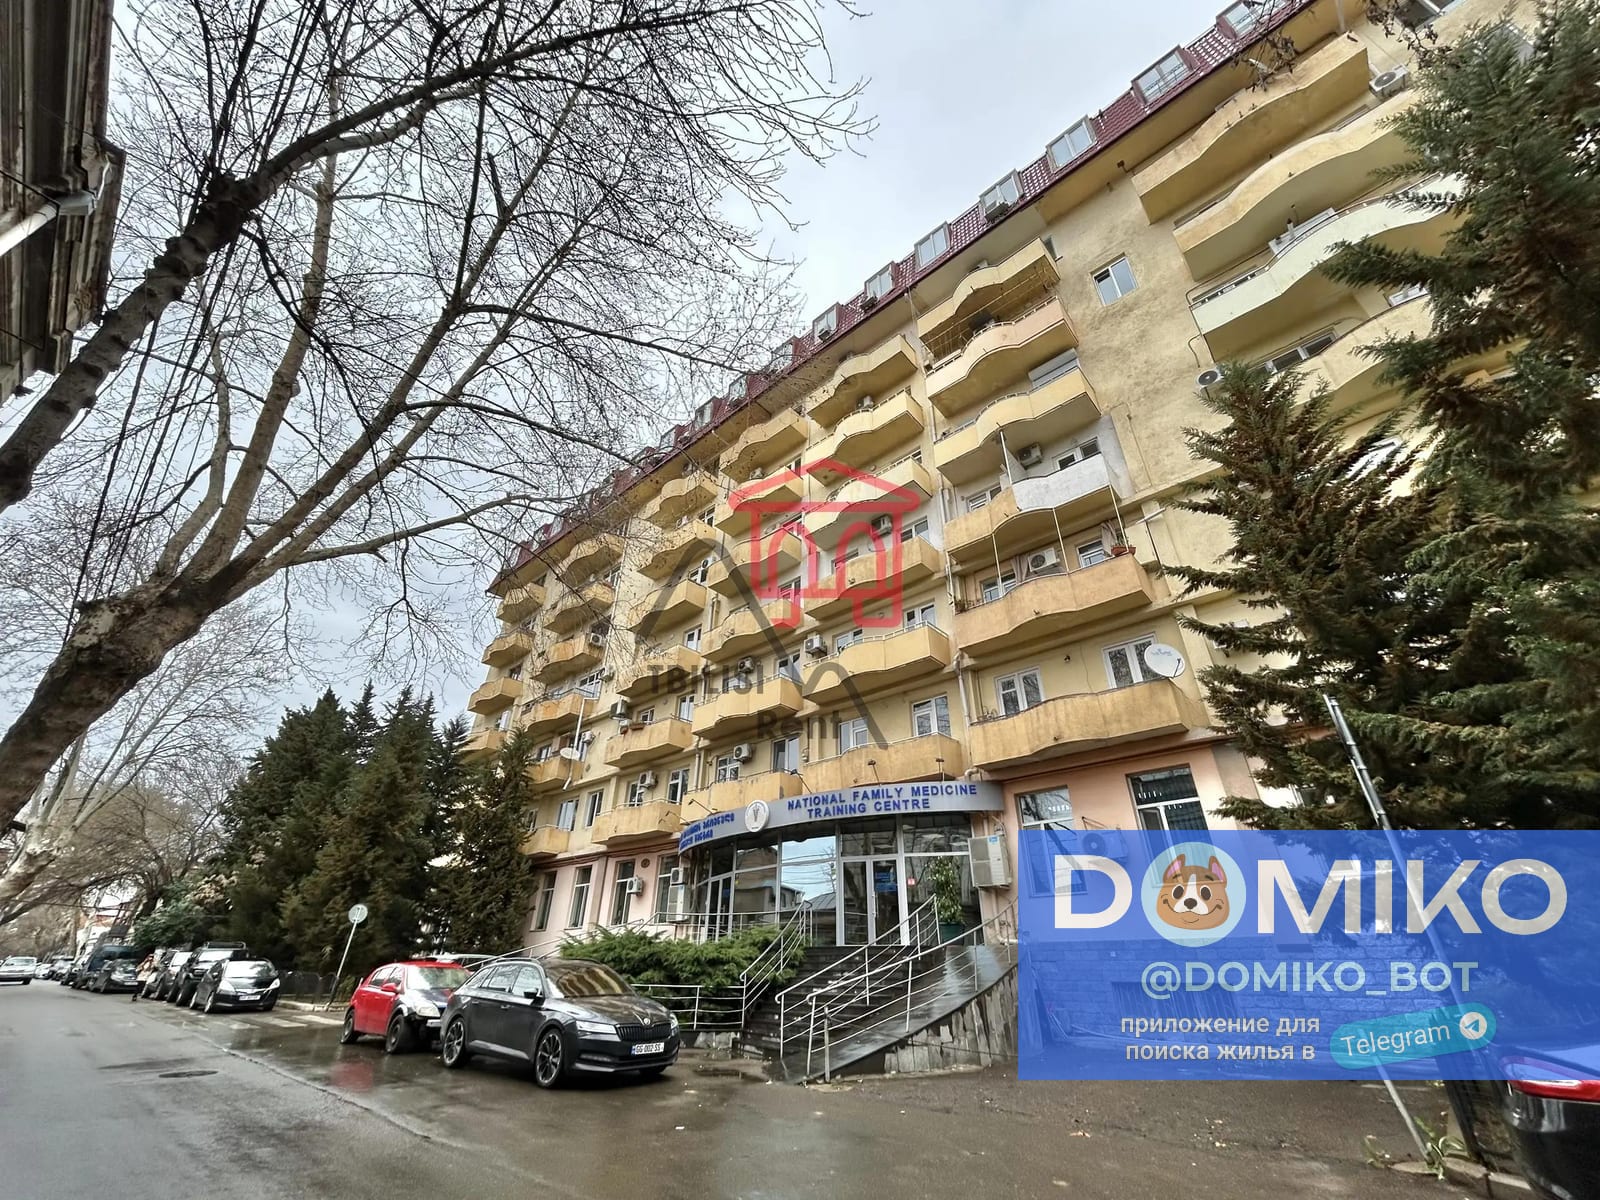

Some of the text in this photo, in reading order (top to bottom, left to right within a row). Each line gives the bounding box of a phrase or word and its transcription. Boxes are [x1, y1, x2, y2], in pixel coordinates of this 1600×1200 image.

[787, 784, 978, 811] NATIONAL FAMILY MEDICINE
[807, 798, 931, 819] TRAINING CENTRE
